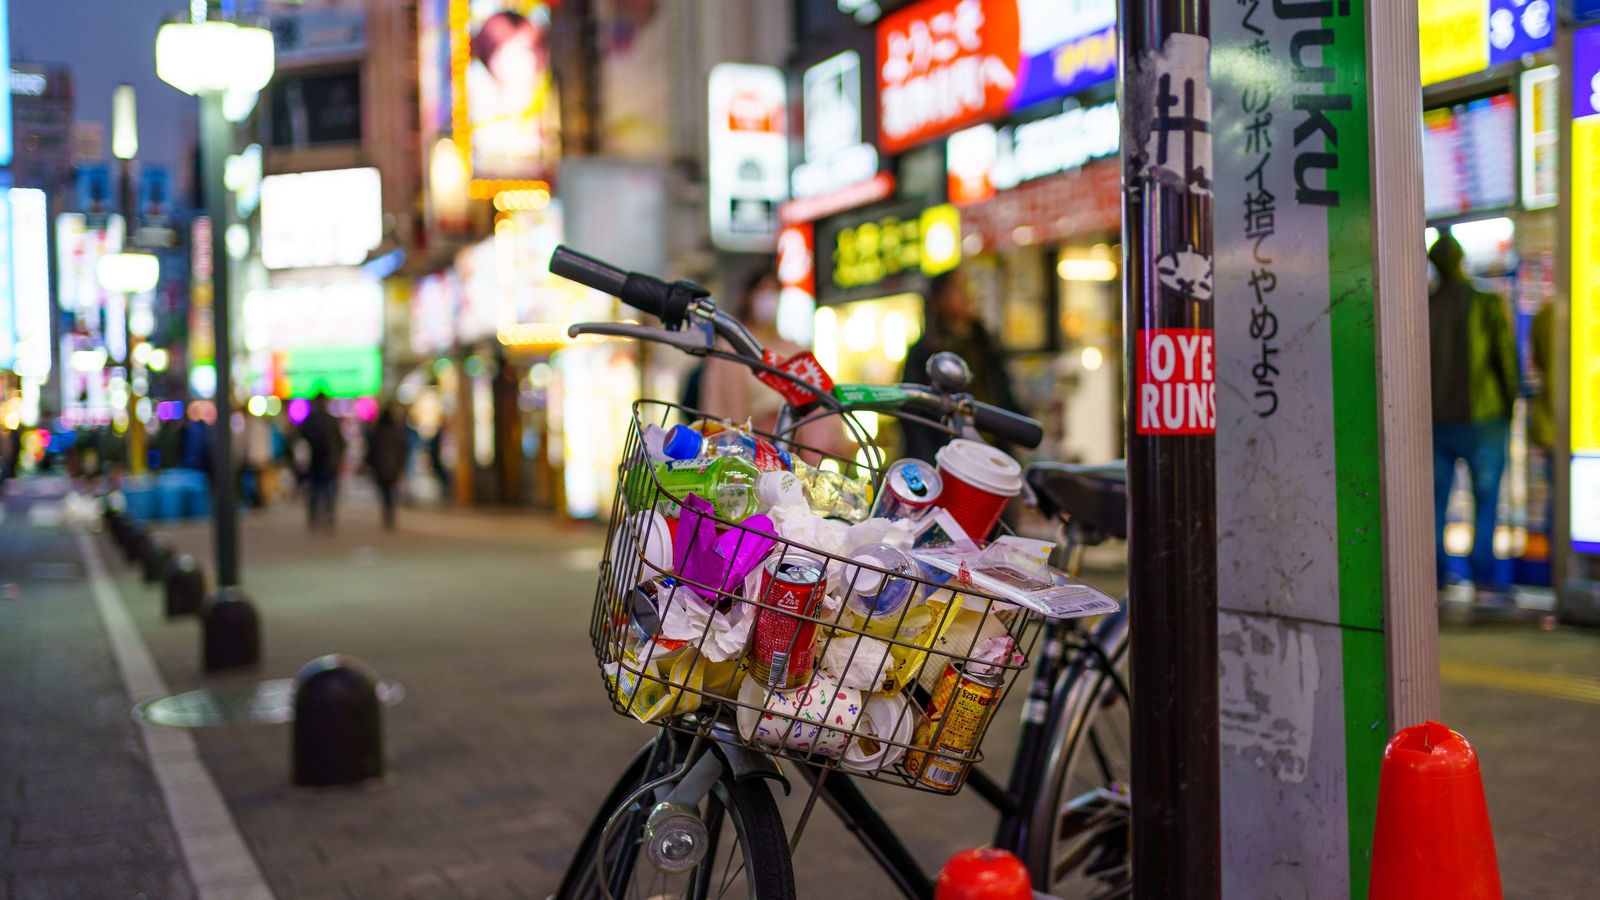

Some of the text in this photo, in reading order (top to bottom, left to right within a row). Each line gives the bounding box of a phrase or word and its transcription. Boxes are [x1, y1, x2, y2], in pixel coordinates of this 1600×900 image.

[1236, 0, 1280, 418] くのポイ捨てやめよう
